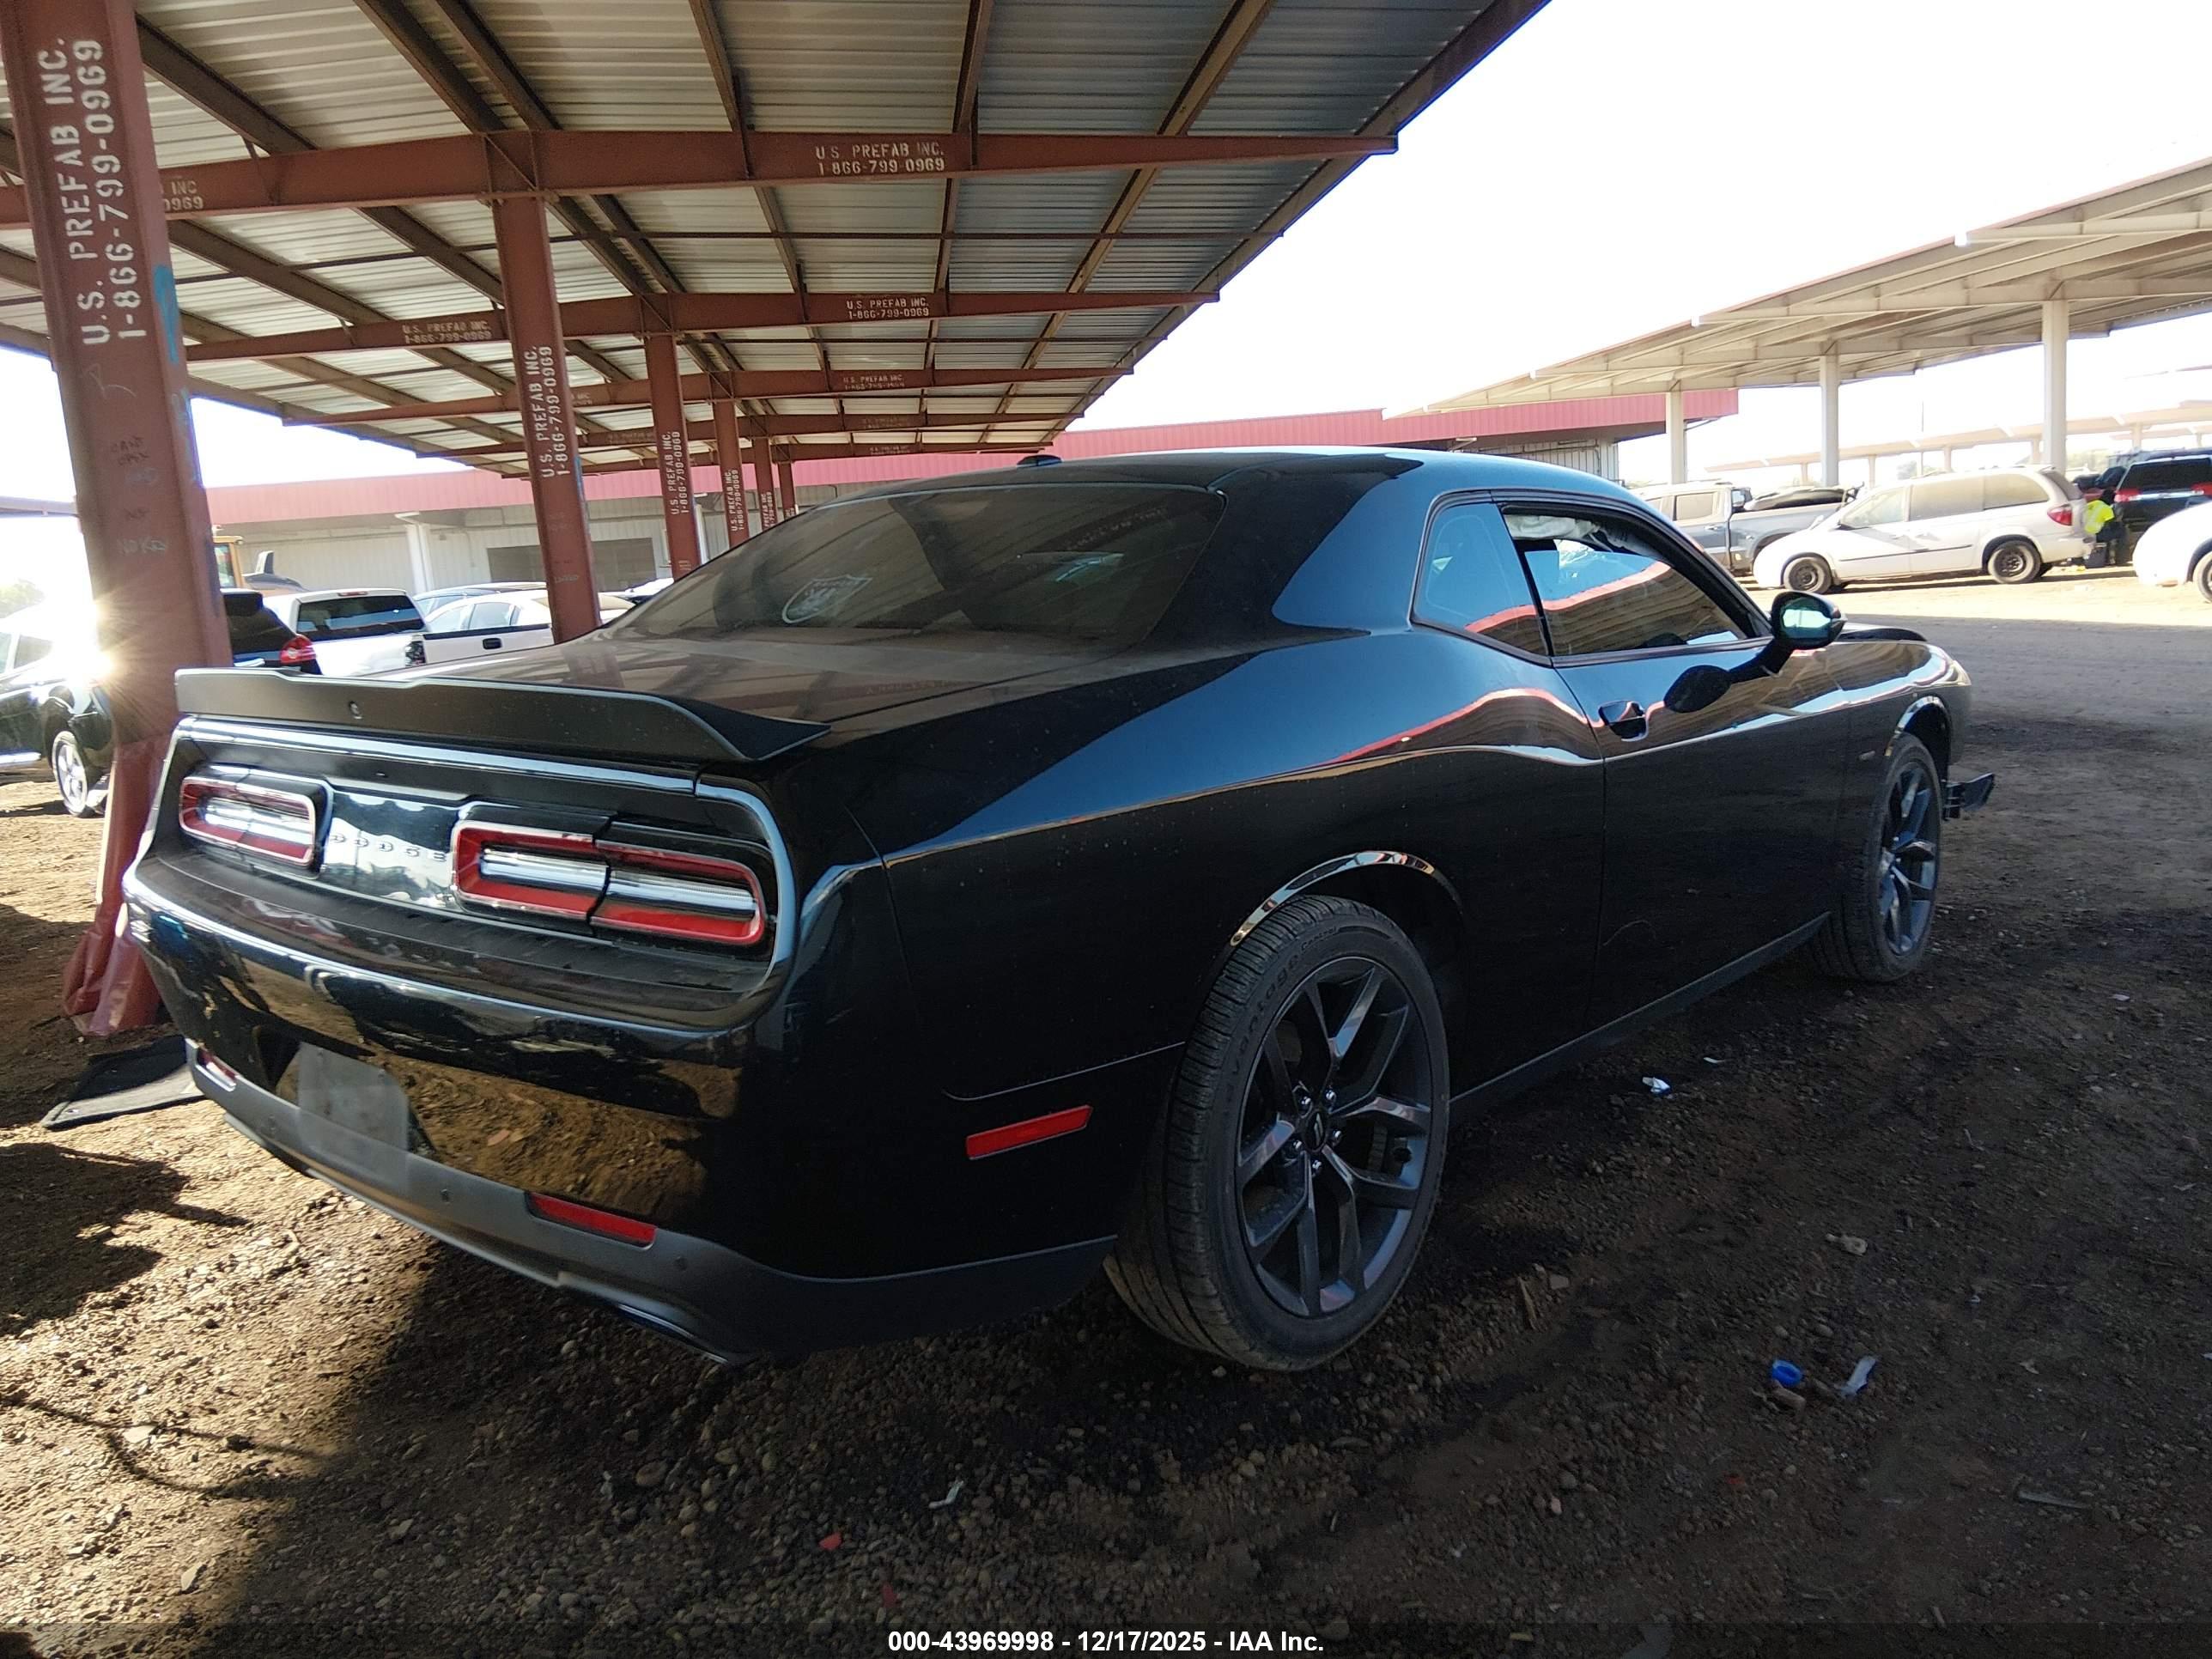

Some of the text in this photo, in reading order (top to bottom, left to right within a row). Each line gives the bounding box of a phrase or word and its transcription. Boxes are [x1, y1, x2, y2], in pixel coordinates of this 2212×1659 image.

[852, 143, 909, 158] PREFAB
[916, 141, 945, 156] INC.
[37, 37, 111, 345] U.S. PREFAB INC.
[73, 40, 148, 341] 1-866-799-0969
[869, 297, 907, 308] PREFAB
[529, 382, 550, 441] PREFAB
[538, 346, 571, 476] 1-866-799-0969
[540, 449, 556, 477] U.S.
[664, 453, 678, 492] PREFAB
